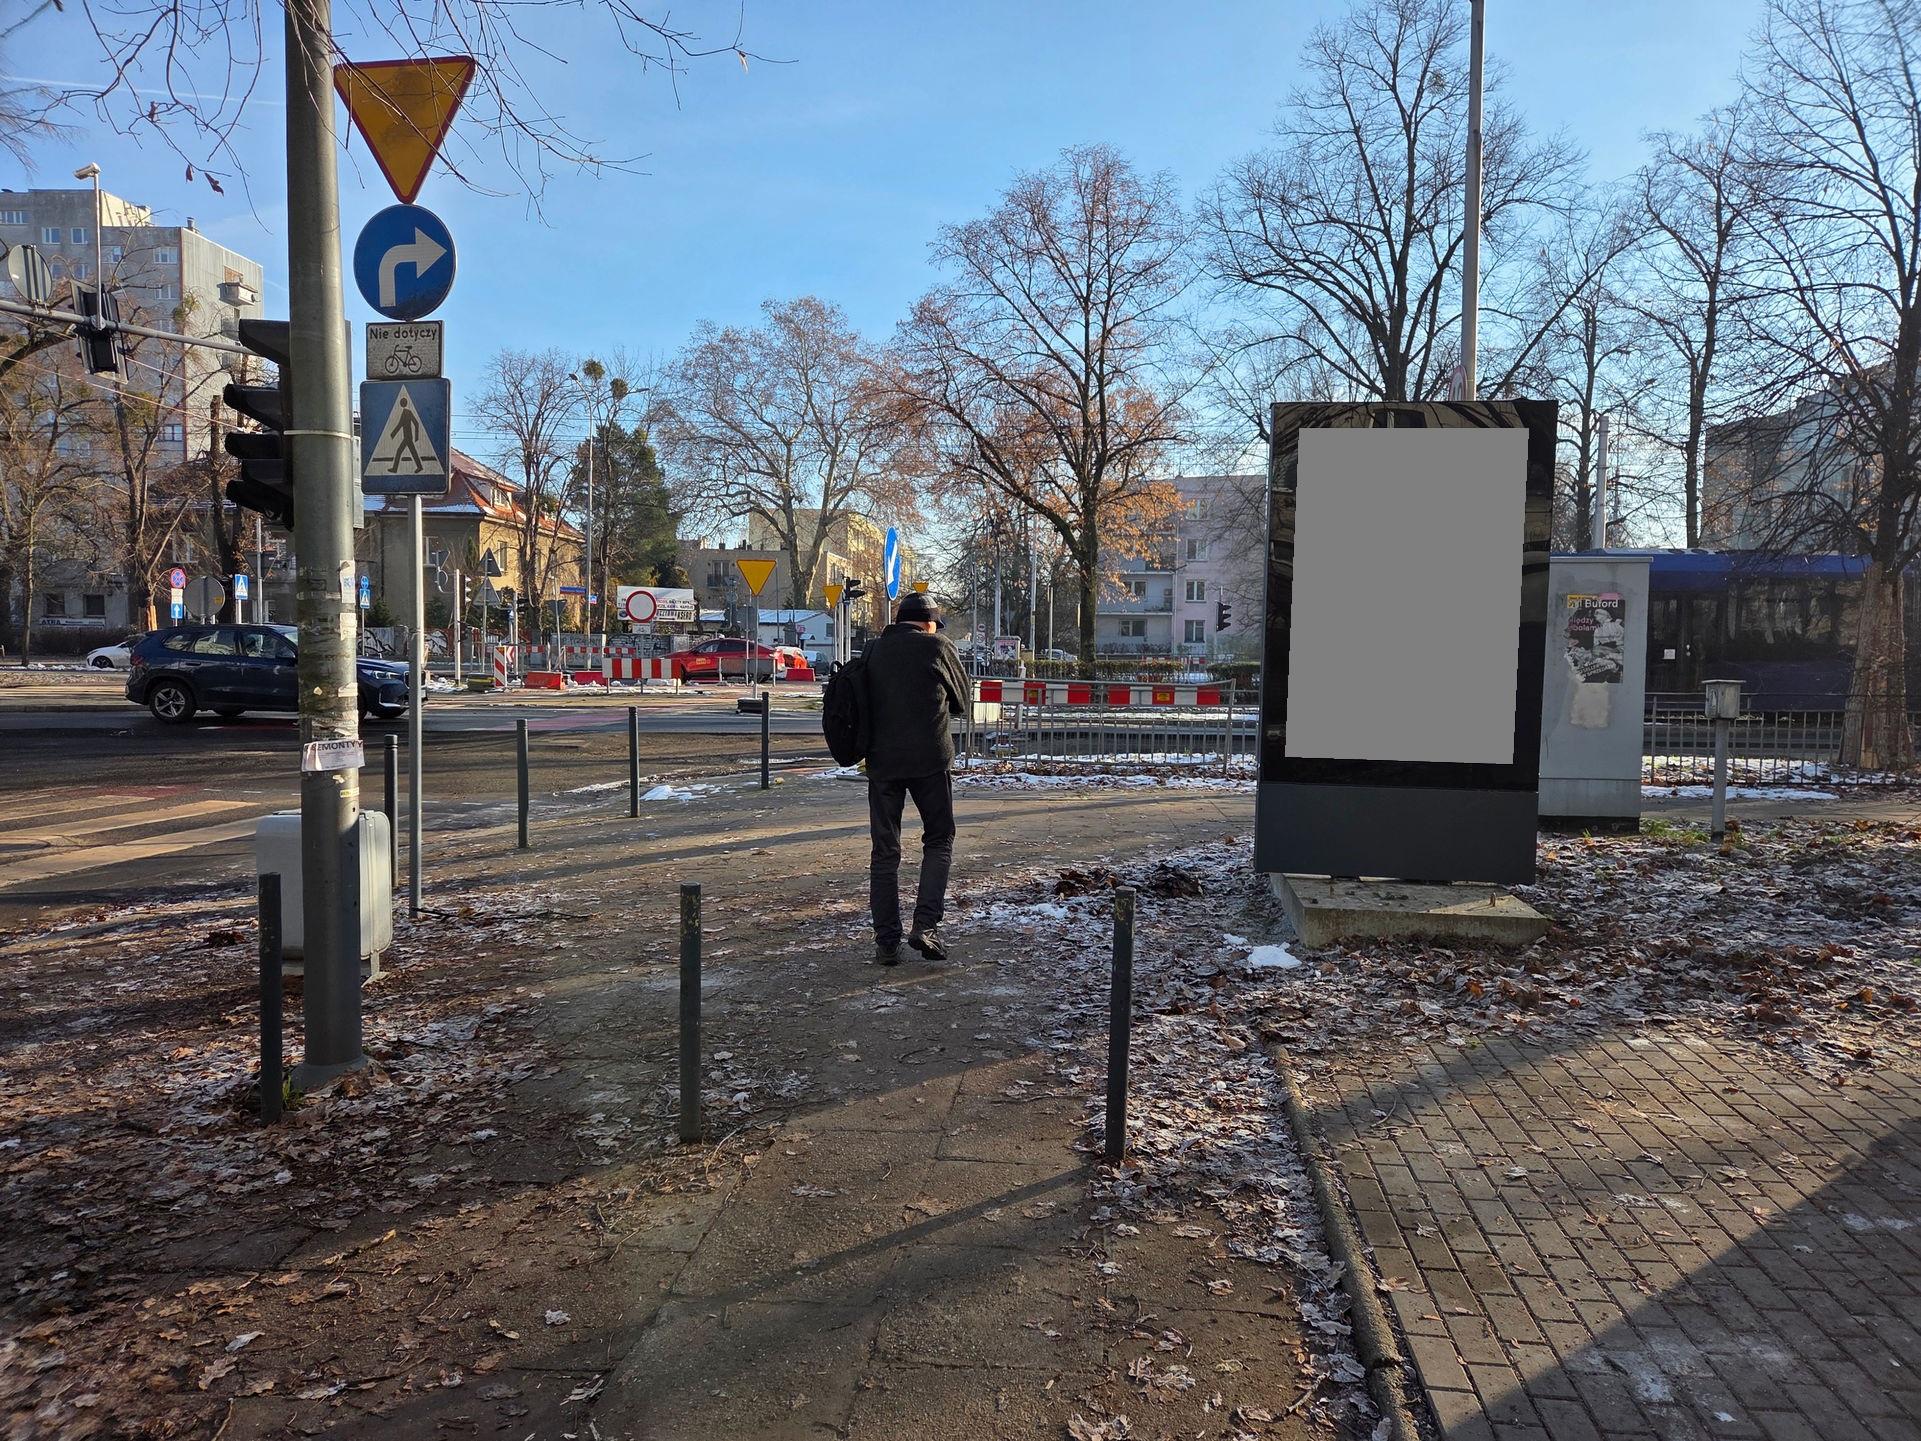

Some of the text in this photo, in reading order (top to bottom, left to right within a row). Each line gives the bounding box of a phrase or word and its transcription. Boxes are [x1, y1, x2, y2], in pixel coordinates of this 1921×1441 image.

[369, 326, 437, 342] Nie dotyczy
[1584, 599, 1618, 608] Buford
